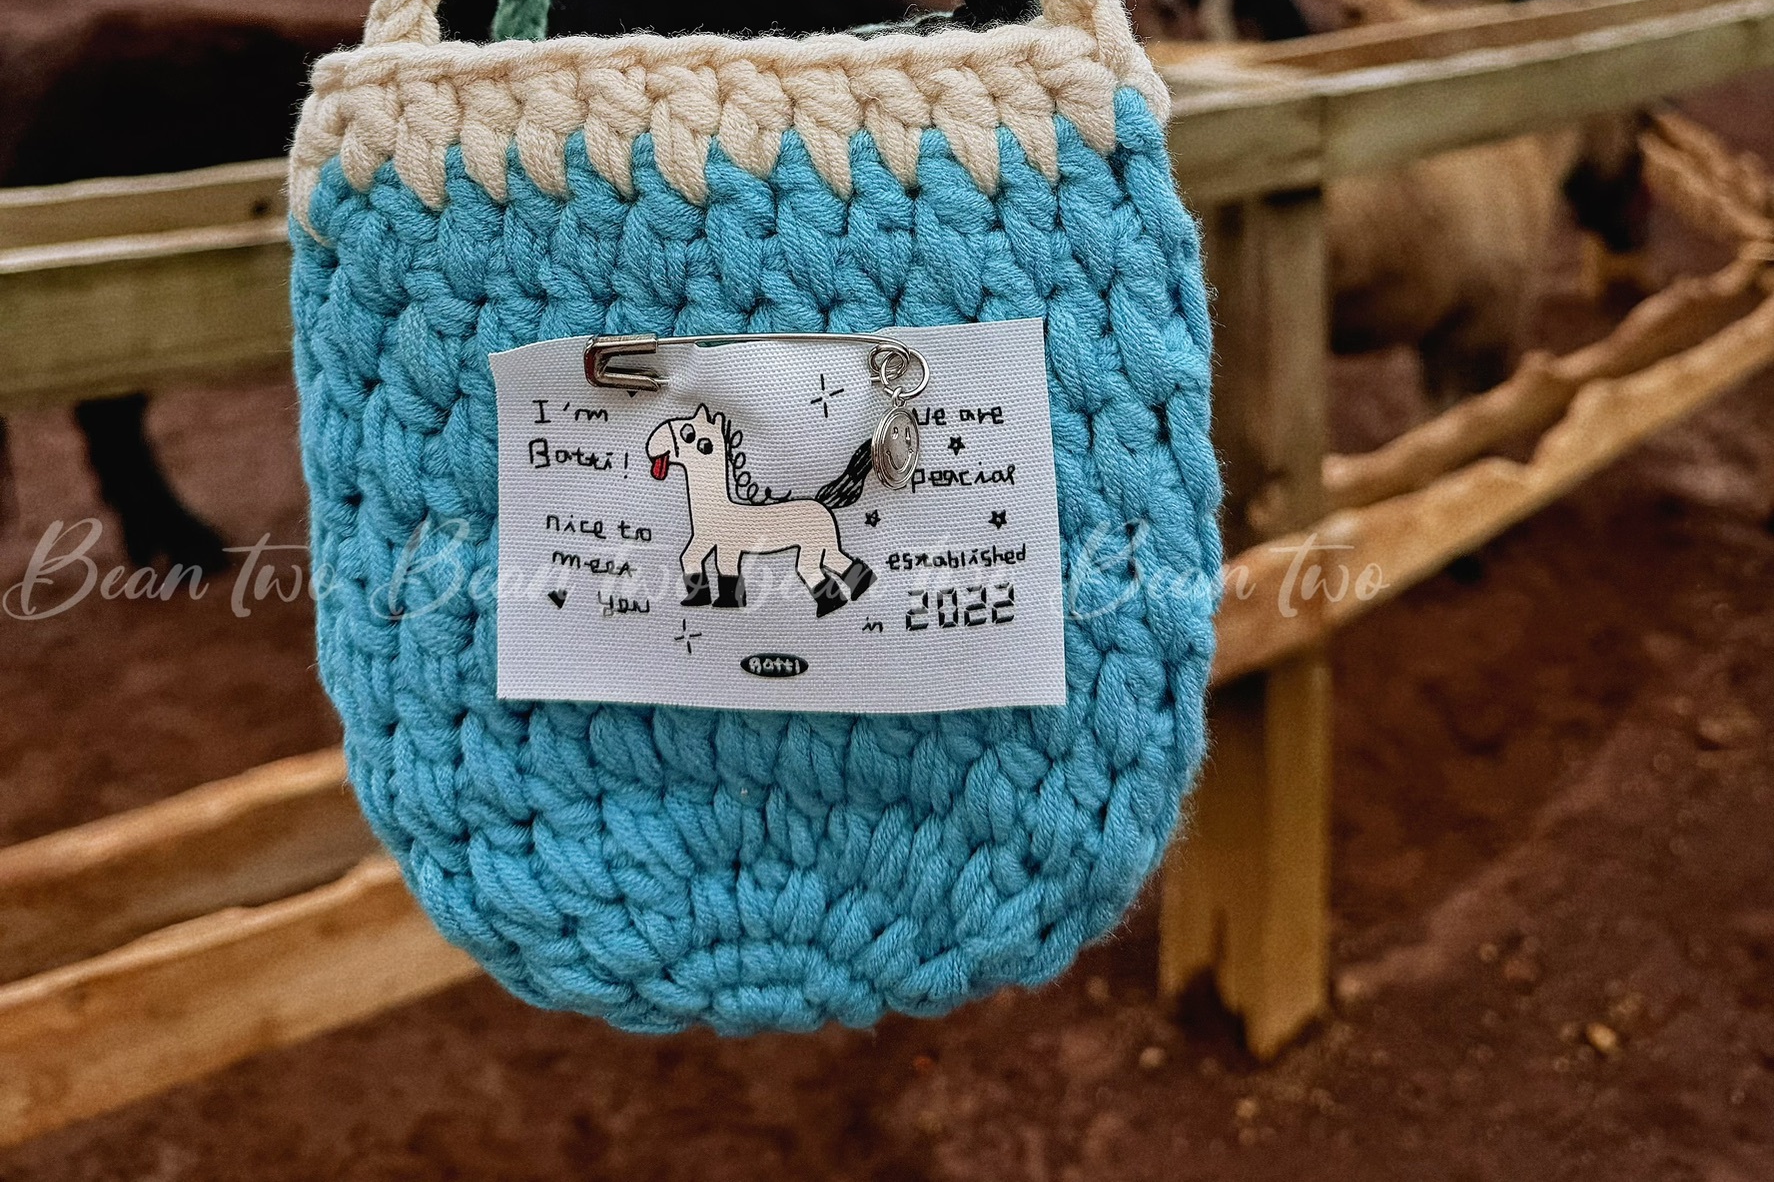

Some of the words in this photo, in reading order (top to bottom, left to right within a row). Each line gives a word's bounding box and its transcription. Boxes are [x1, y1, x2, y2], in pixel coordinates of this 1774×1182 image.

[532, 399, 609, 424] I'm
[959, 405, 1004, 425] are
[546, 514, 607, 540] nice
[618, 520, 653, 542] to
[885, 542, 1027, 570] established
[862, 616, 884, 633] in
[905, 581, 1015, 632] 2022
